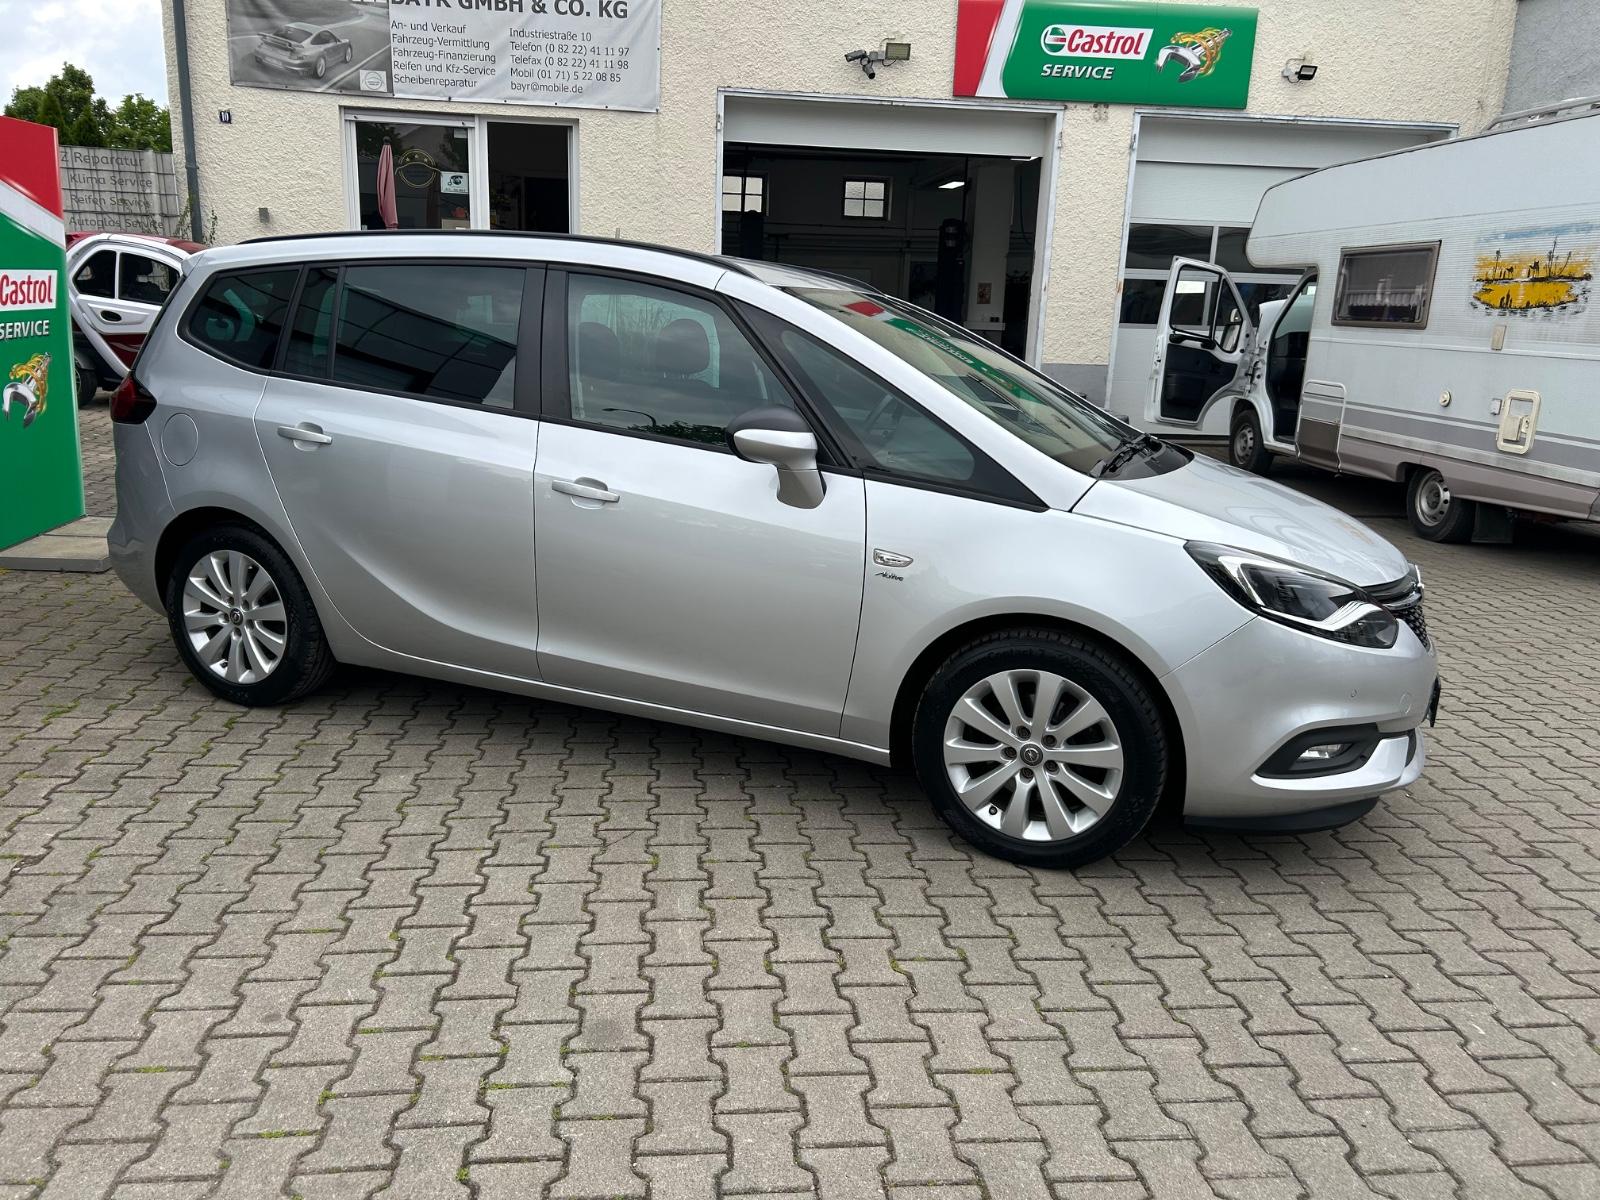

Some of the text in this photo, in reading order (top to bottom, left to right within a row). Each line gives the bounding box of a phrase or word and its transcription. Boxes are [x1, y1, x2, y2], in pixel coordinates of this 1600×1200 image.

[531, 0, 548, 14] &
[554, 0, 591, 17] CO.
[598, 0, 628, 19] KG
[391, 20, 467, 34] An- und Verkauf
[509, 27, 592, 42] Industriestraße 10
[392, 33, 490, 51] Fahrzeug-Vermittlung
[509, 41, 630, 57] Telefon (0 82 22) 41 11 97
[1067, 28, 1145, 56] Castrol
[393, 47, 496, 64] Fahrzeug-Finanzierung
[510, 54, 629, 70] Telefax (0 82 22) 41 11 98
[393, 60, 496, 76] Reifen und Kfz-Service
[510, 67, 621, 83] Mobil (01 71) 5 22 08 85
[1041, 64, 1115, 80] SERVICE
[393, 73, 478, 88] Scheibenreparatur
[510, 81, 583, 95] bayr@mobile.de
[74, 151, 145, 168] Reparatur
[70, 173, 153, 188] Klima Service
[71, 194, 107, 206] Reifen
[69, 216, 121, 230] Autoglas
[0, 274, 53, 306] Castrol
[0, 320, 50, 340] SERVICE
